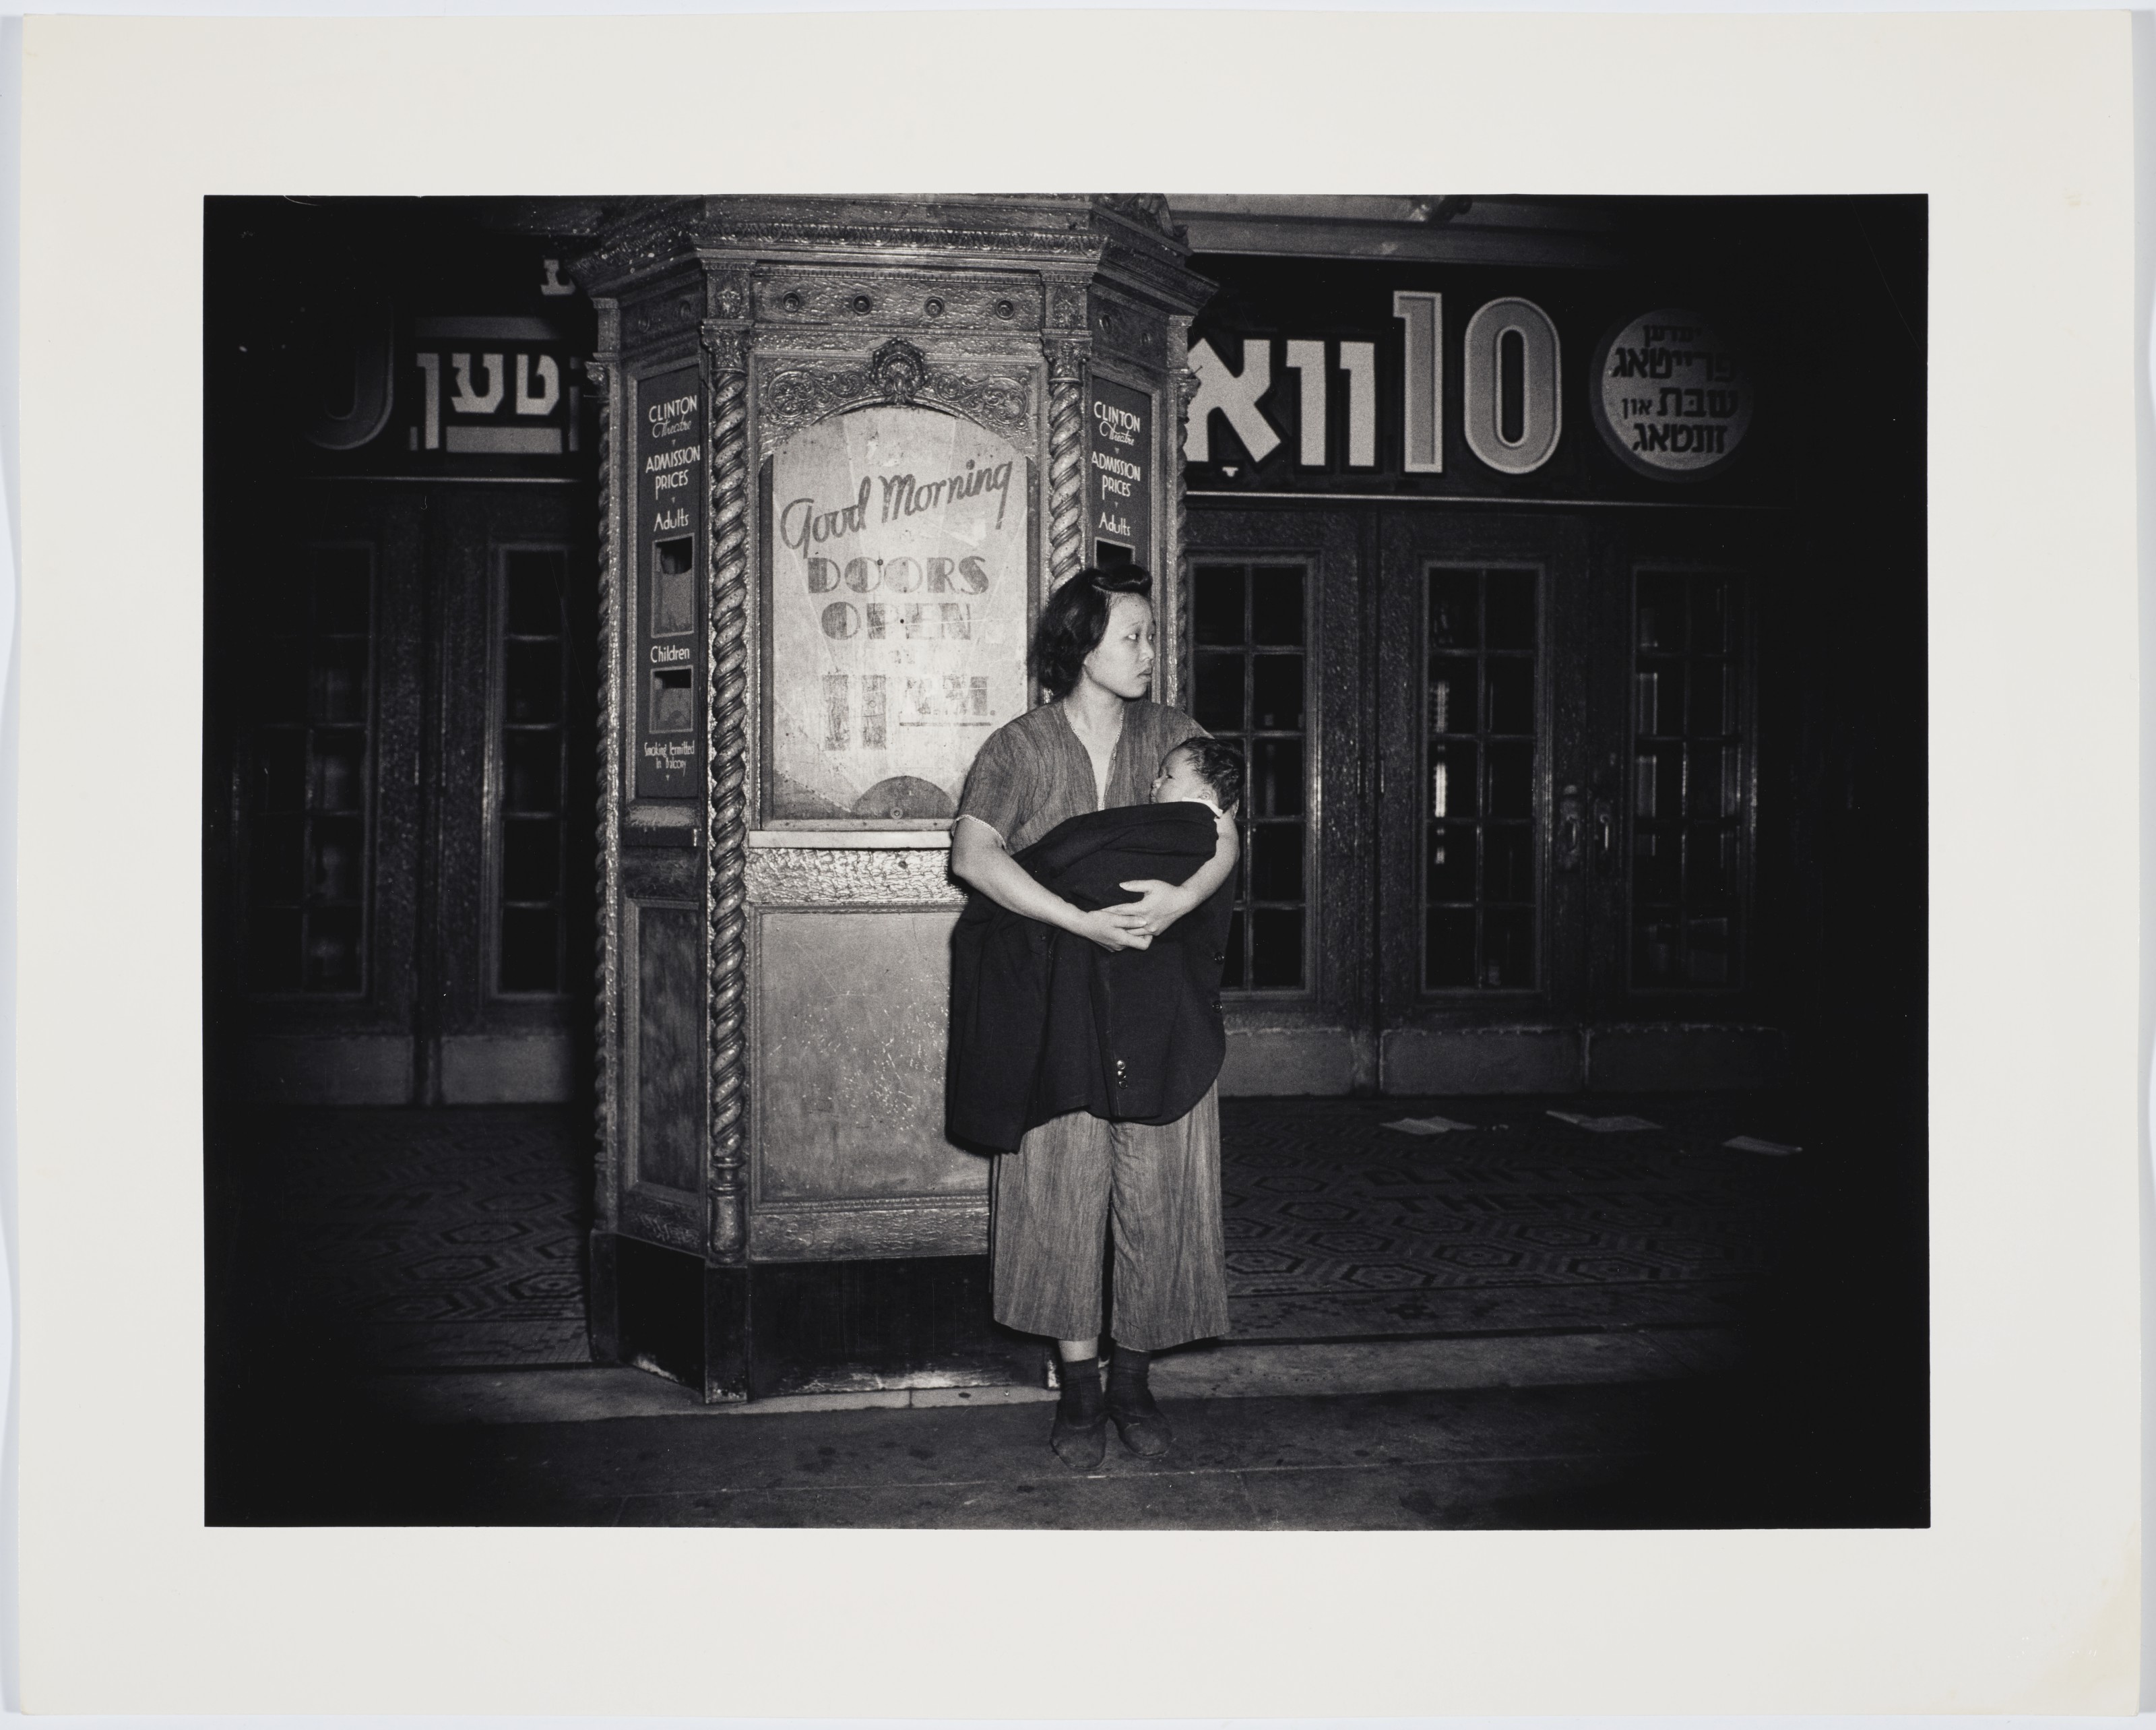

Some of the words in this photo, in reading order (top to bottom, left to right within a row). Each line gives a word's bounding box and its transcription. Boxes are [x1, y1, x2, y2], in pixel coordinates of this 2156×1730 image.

[1393, 290, 1563, 474] 10
[415, 352, 581, 450] טען
[648, 394, 698, 423] CLINTON
[1621, 398, 1652, 420] און
[1657, 386, 1739, 419] שבת
[652, 413, 692, 439] Theatre
[1093, 401, 1141, 433] CLINTON
[1632, 423, 1728, 454] זונטאג
[645, 445, 701, 474] ADMISSION
[1091, 450, 1141, 482] ADMISSION
[655, 469, 689, 500] PRICES
[1102, 474, 1131, 500] PRICES
[653, 507, 689, 532] Adults
[780, 475, 872, 559] Good
[878, 458, 1014, 530] Morning
[1098, 511, 1131, 536] Adults
[807, 555, 990, 594] DOORS
[821, 601, 972, 641] OPEN
[649, 644, 691, 664] Children
